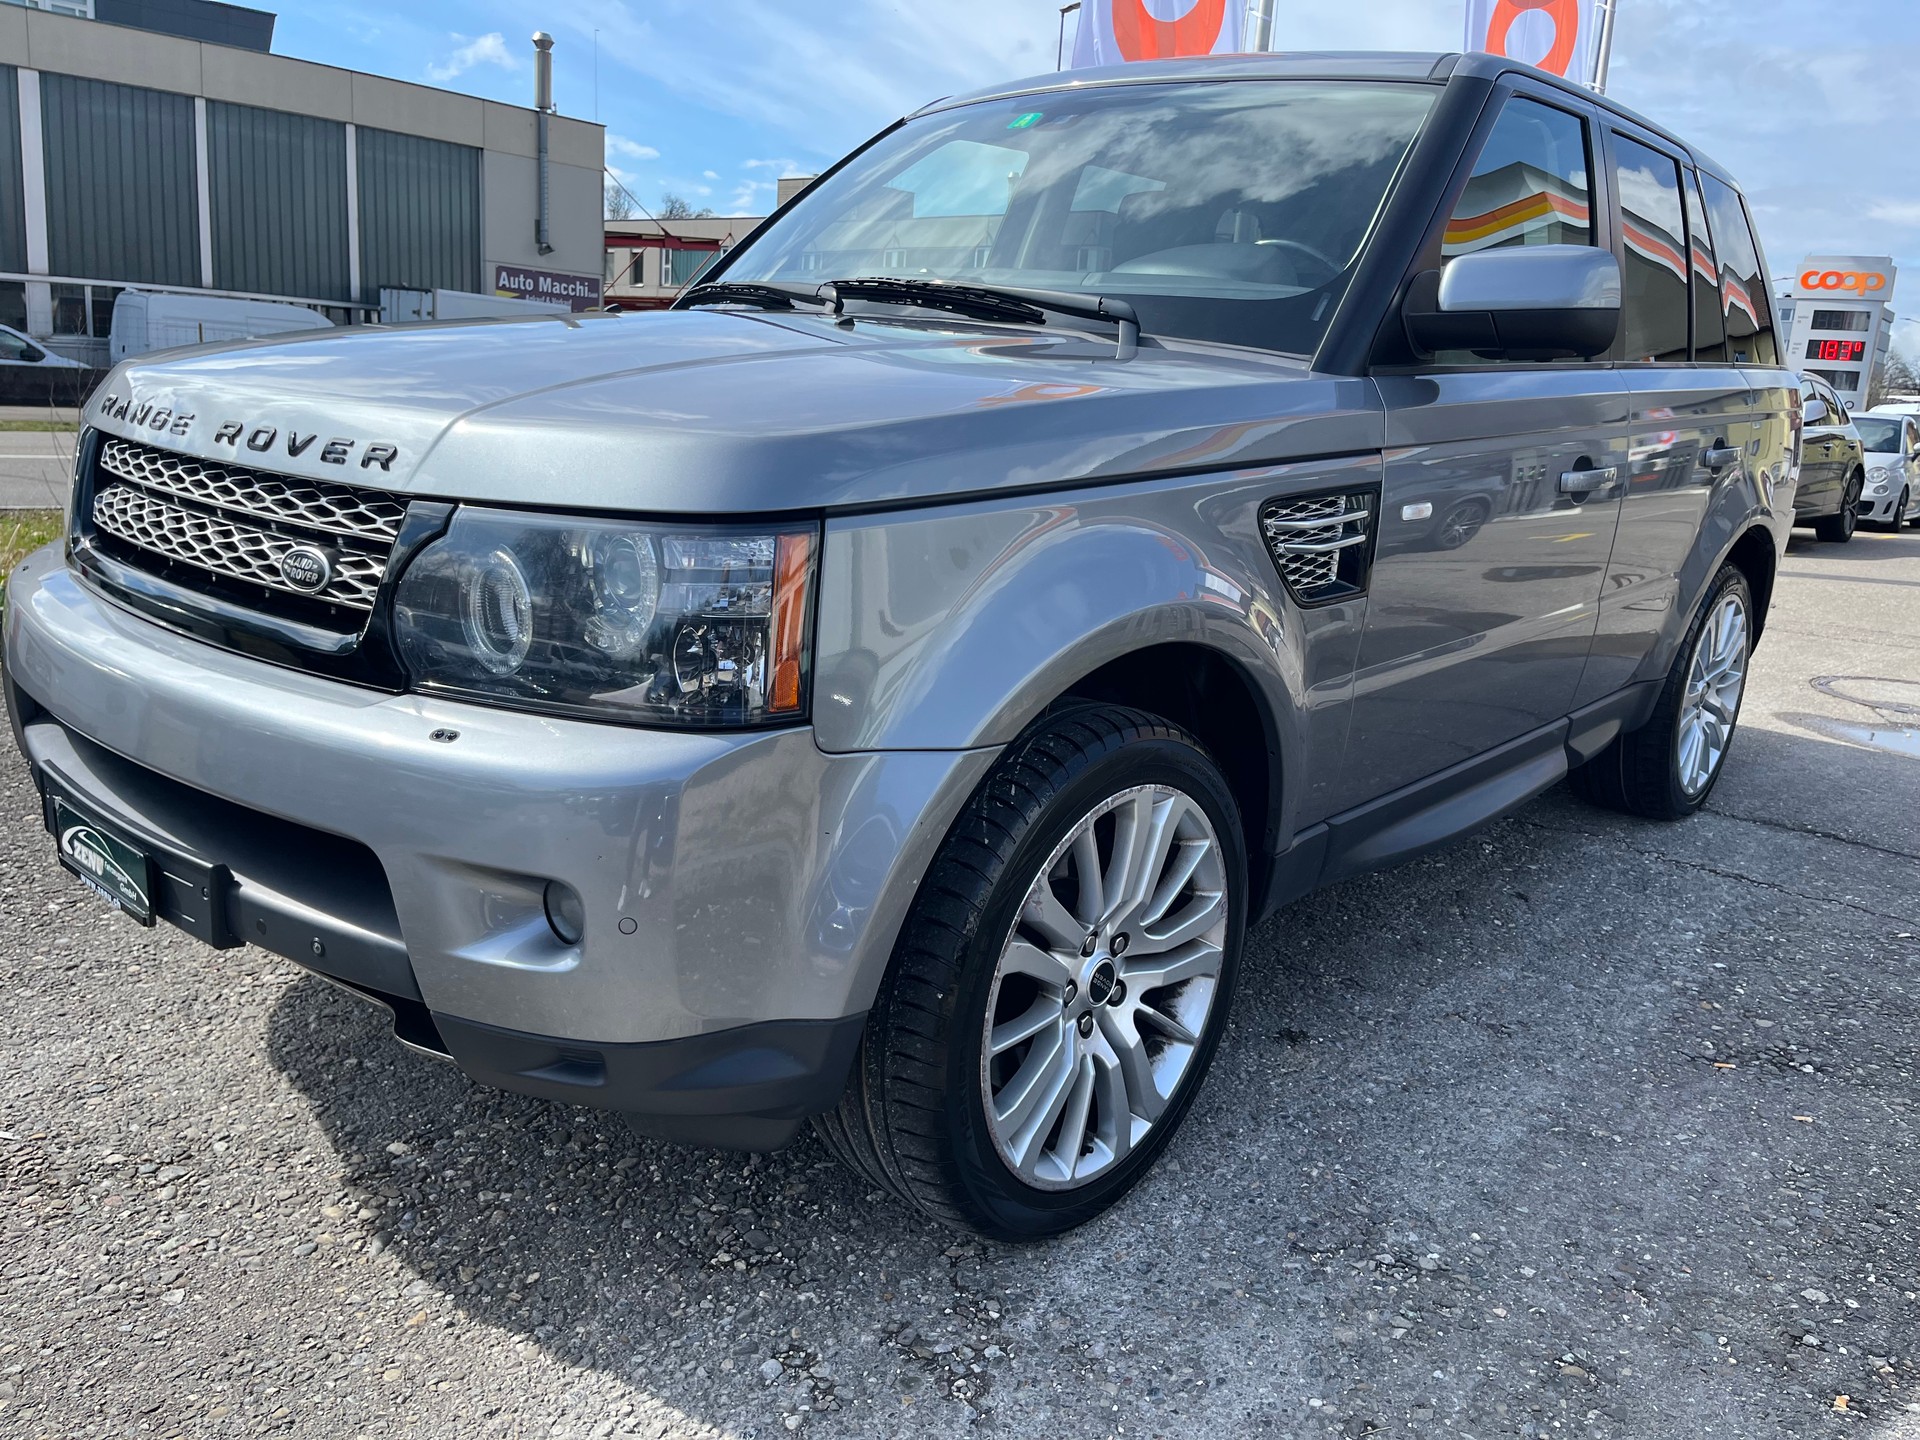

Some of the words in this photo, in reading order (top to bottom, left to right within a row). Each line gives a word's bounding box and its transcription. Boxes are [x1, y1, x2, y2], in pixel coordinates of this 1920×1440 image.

[499, 271, 534, 291] Auto
[538, 276, 588, 298] Macchi
[1800, 270, 1885, 296] coop
[100, 393, 196, 436] RANGE
[214, 419, 398, 472] ROVER
[289, 556, 313, 570] LAND
[290, 567, 319, 584] ROVER
[119, 882, 137, 901] GmbH
